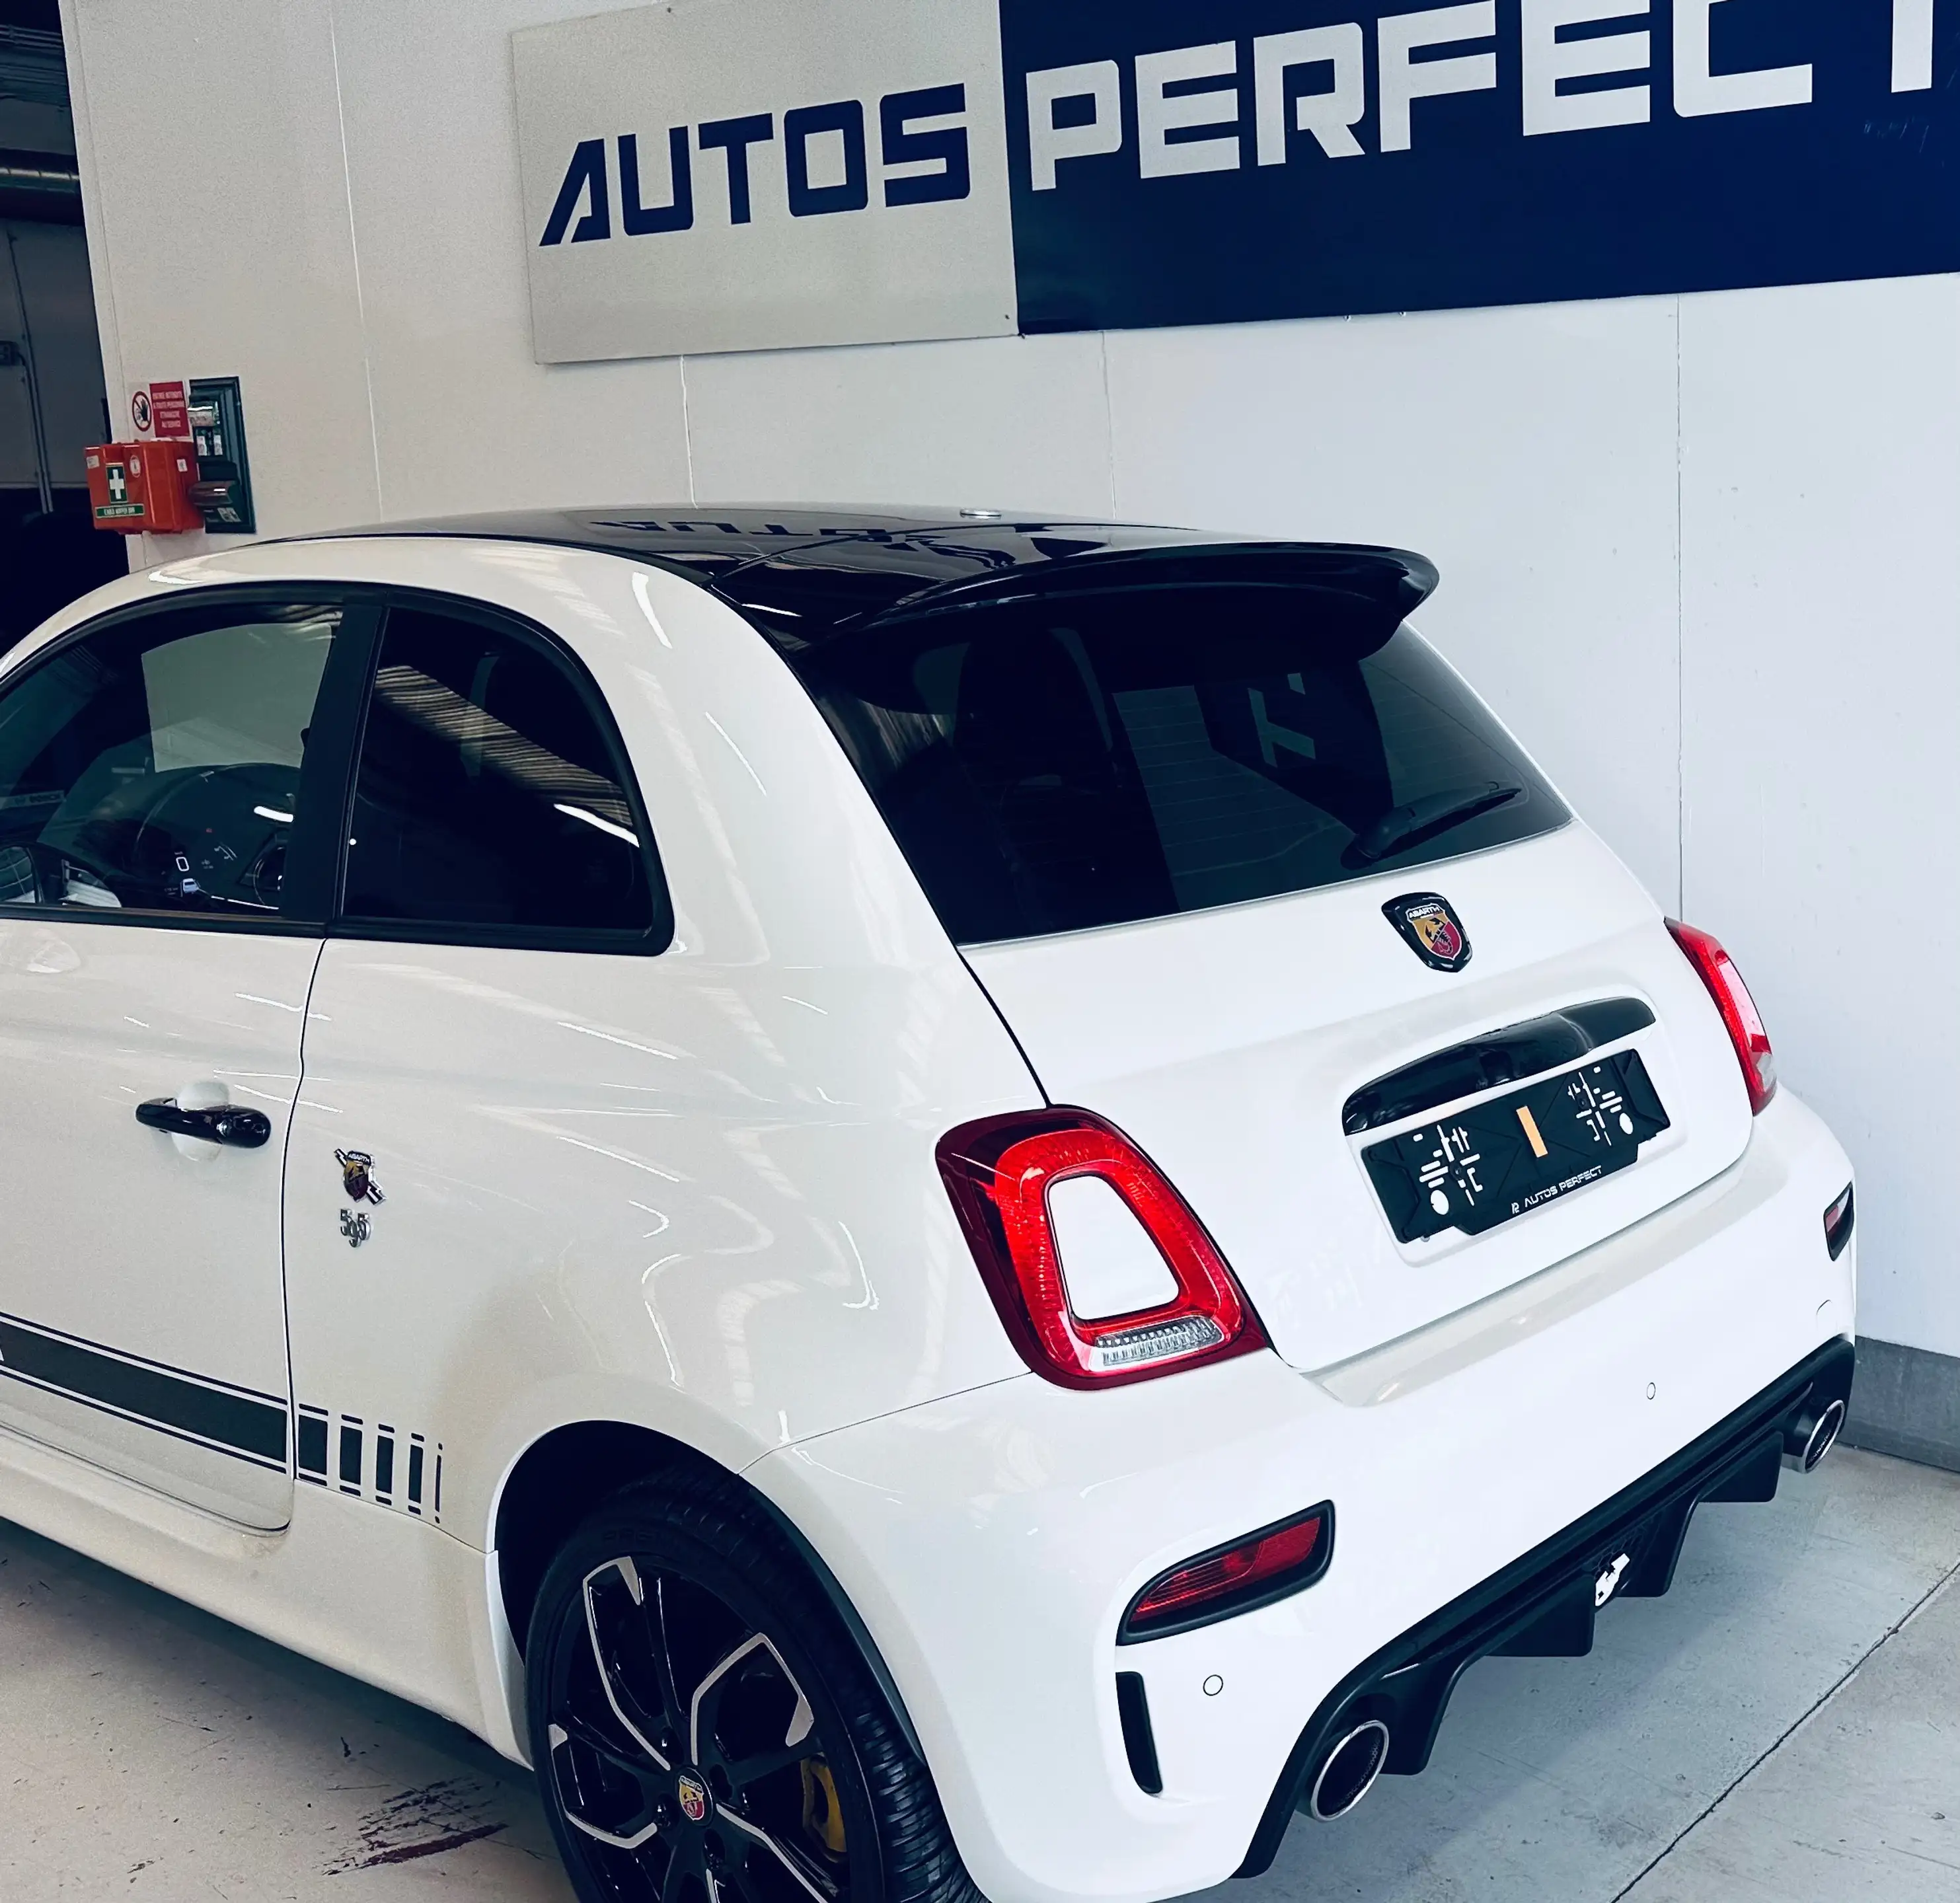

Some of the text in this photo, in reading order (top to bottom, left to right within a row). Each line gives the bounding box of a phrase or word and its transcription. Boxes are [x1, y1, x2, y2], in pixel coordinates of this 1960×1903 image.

[539, 83, 970, 246] AUTOS
[1410, 907, 1439, 918] ABARTH
[1525, 1185, 1558, 1207] AUTOS
[1560, 1165, 1602, 1191] PERFECT
[341, 1209, 371, 1248] 595
